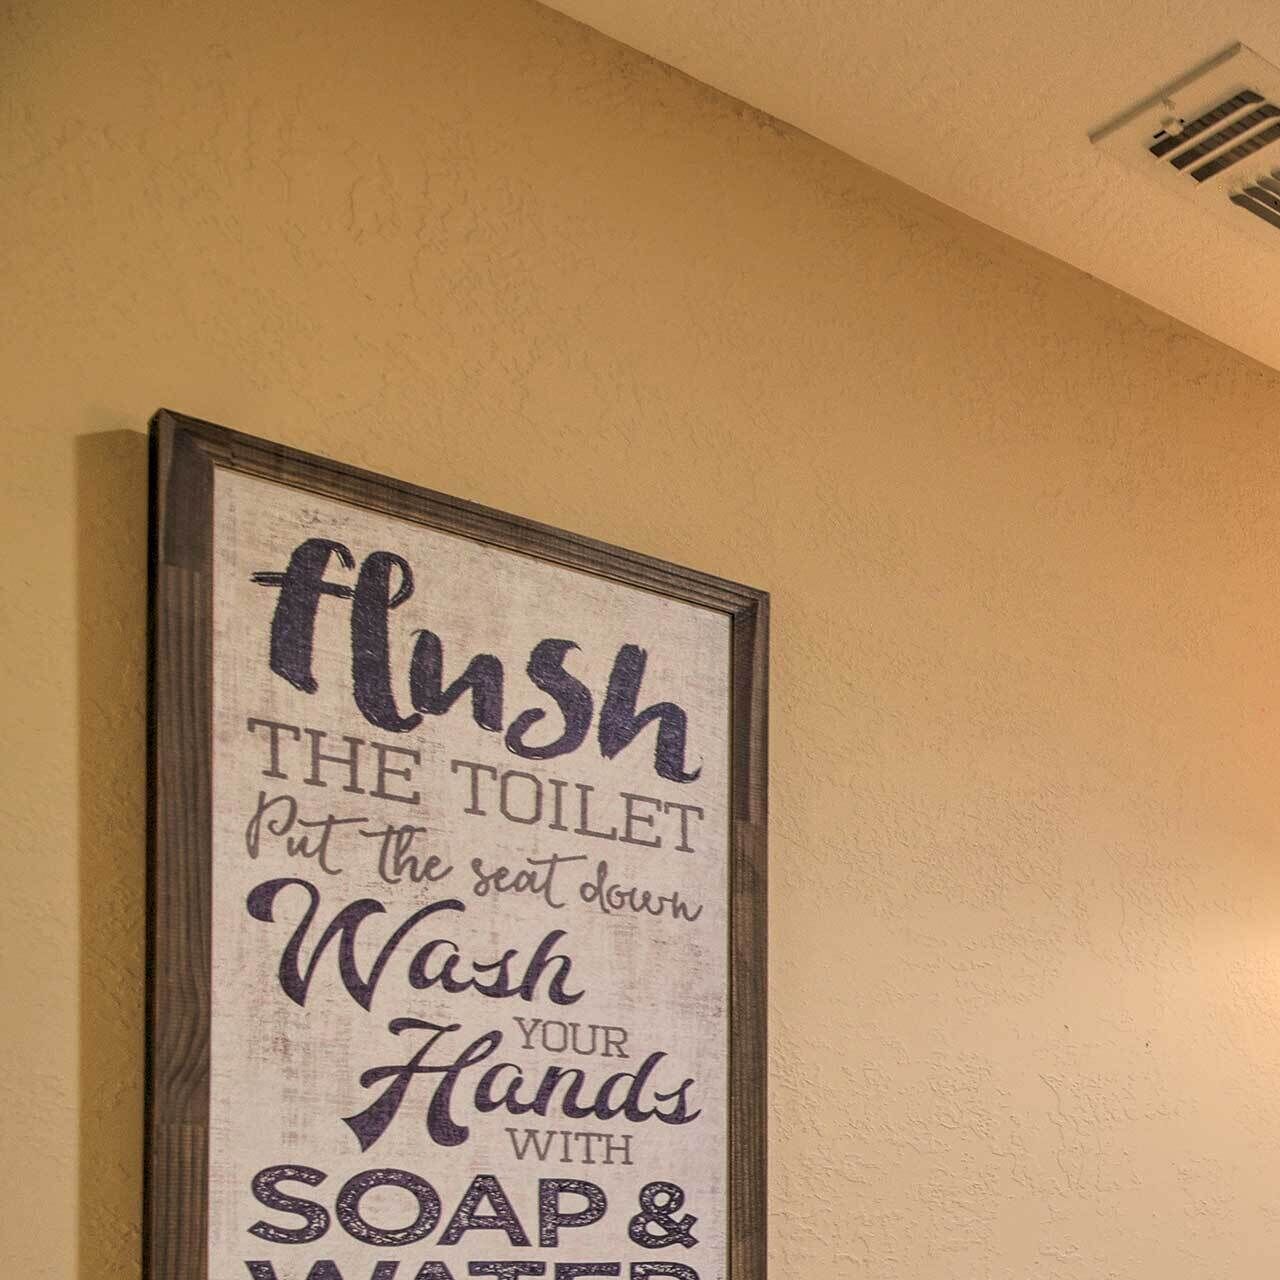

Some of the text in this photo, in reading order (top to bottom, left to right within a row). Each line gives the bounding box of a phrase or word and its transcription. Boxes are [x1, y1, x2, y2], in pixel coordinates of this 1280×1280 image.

[249, 538, 704, 784] flush
[247, 717, 704, 853] THE TOILET
[246, 790, 703, 922] Put the seat down
[246, 877, 585, 1013] Wash
[341, 1016, 702, 1153] Hands
[513, 1017, 630, 1059] YOUR
[247, 1164, 699, 1249] SOAP &
[505, 1127, 634, 1165] WITH
